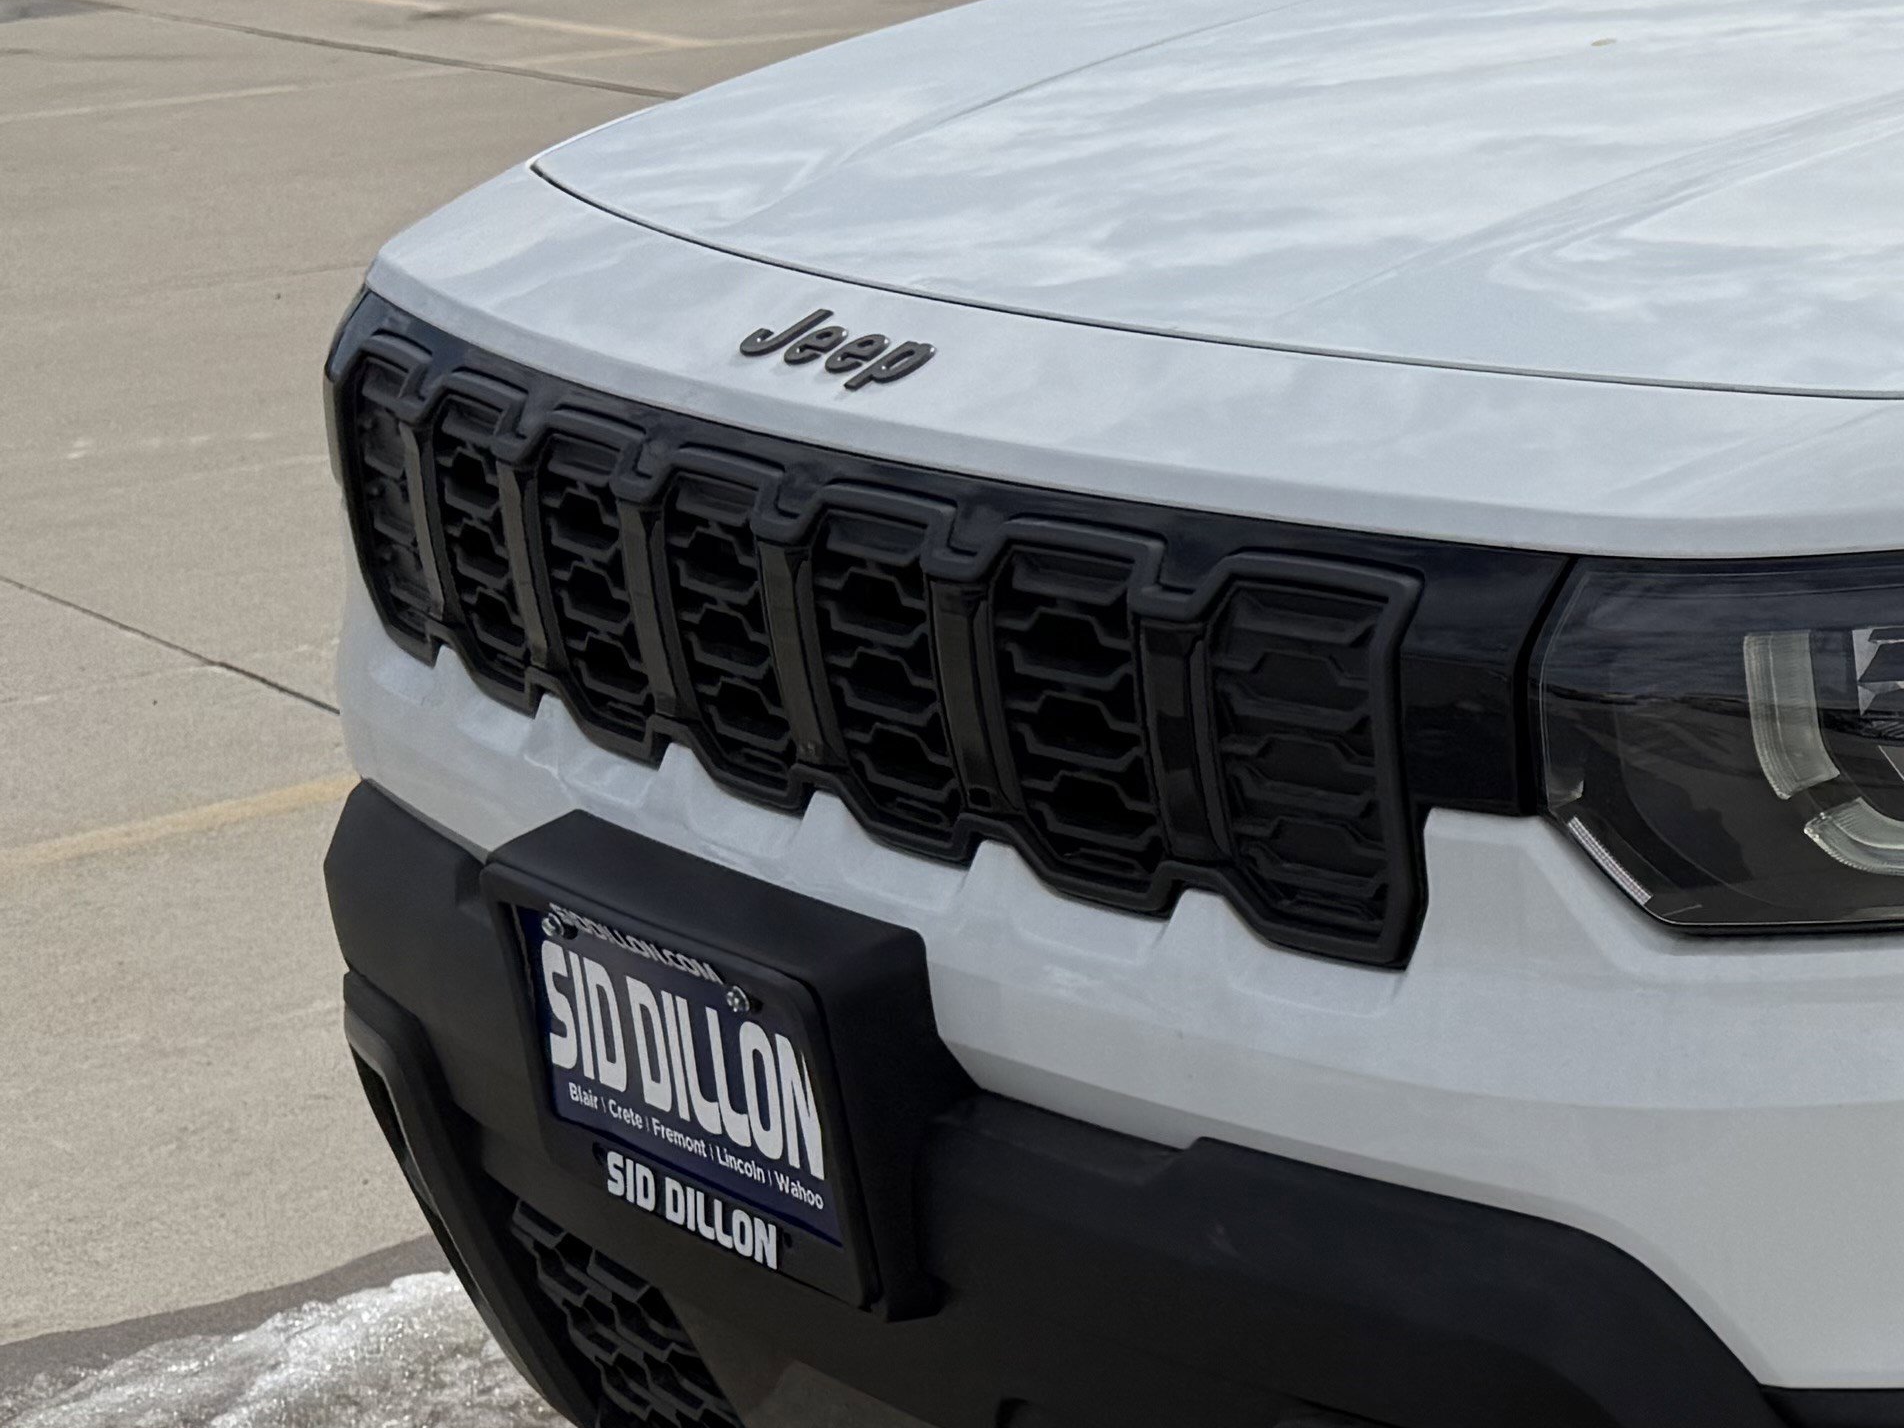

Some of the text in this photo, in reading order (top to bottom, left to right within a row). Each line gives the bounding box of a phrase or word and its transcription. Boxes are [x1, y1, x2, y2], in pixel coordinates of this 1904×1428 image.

[740, 308, 938, 392] Jeep
[541, 940, 825, 1180] SID DILLON
[568, 1081, 825, 1210] Blair Crete Fremont Lincoln Wahoo
[606, 1150, 778, 1271] SID DILLON
